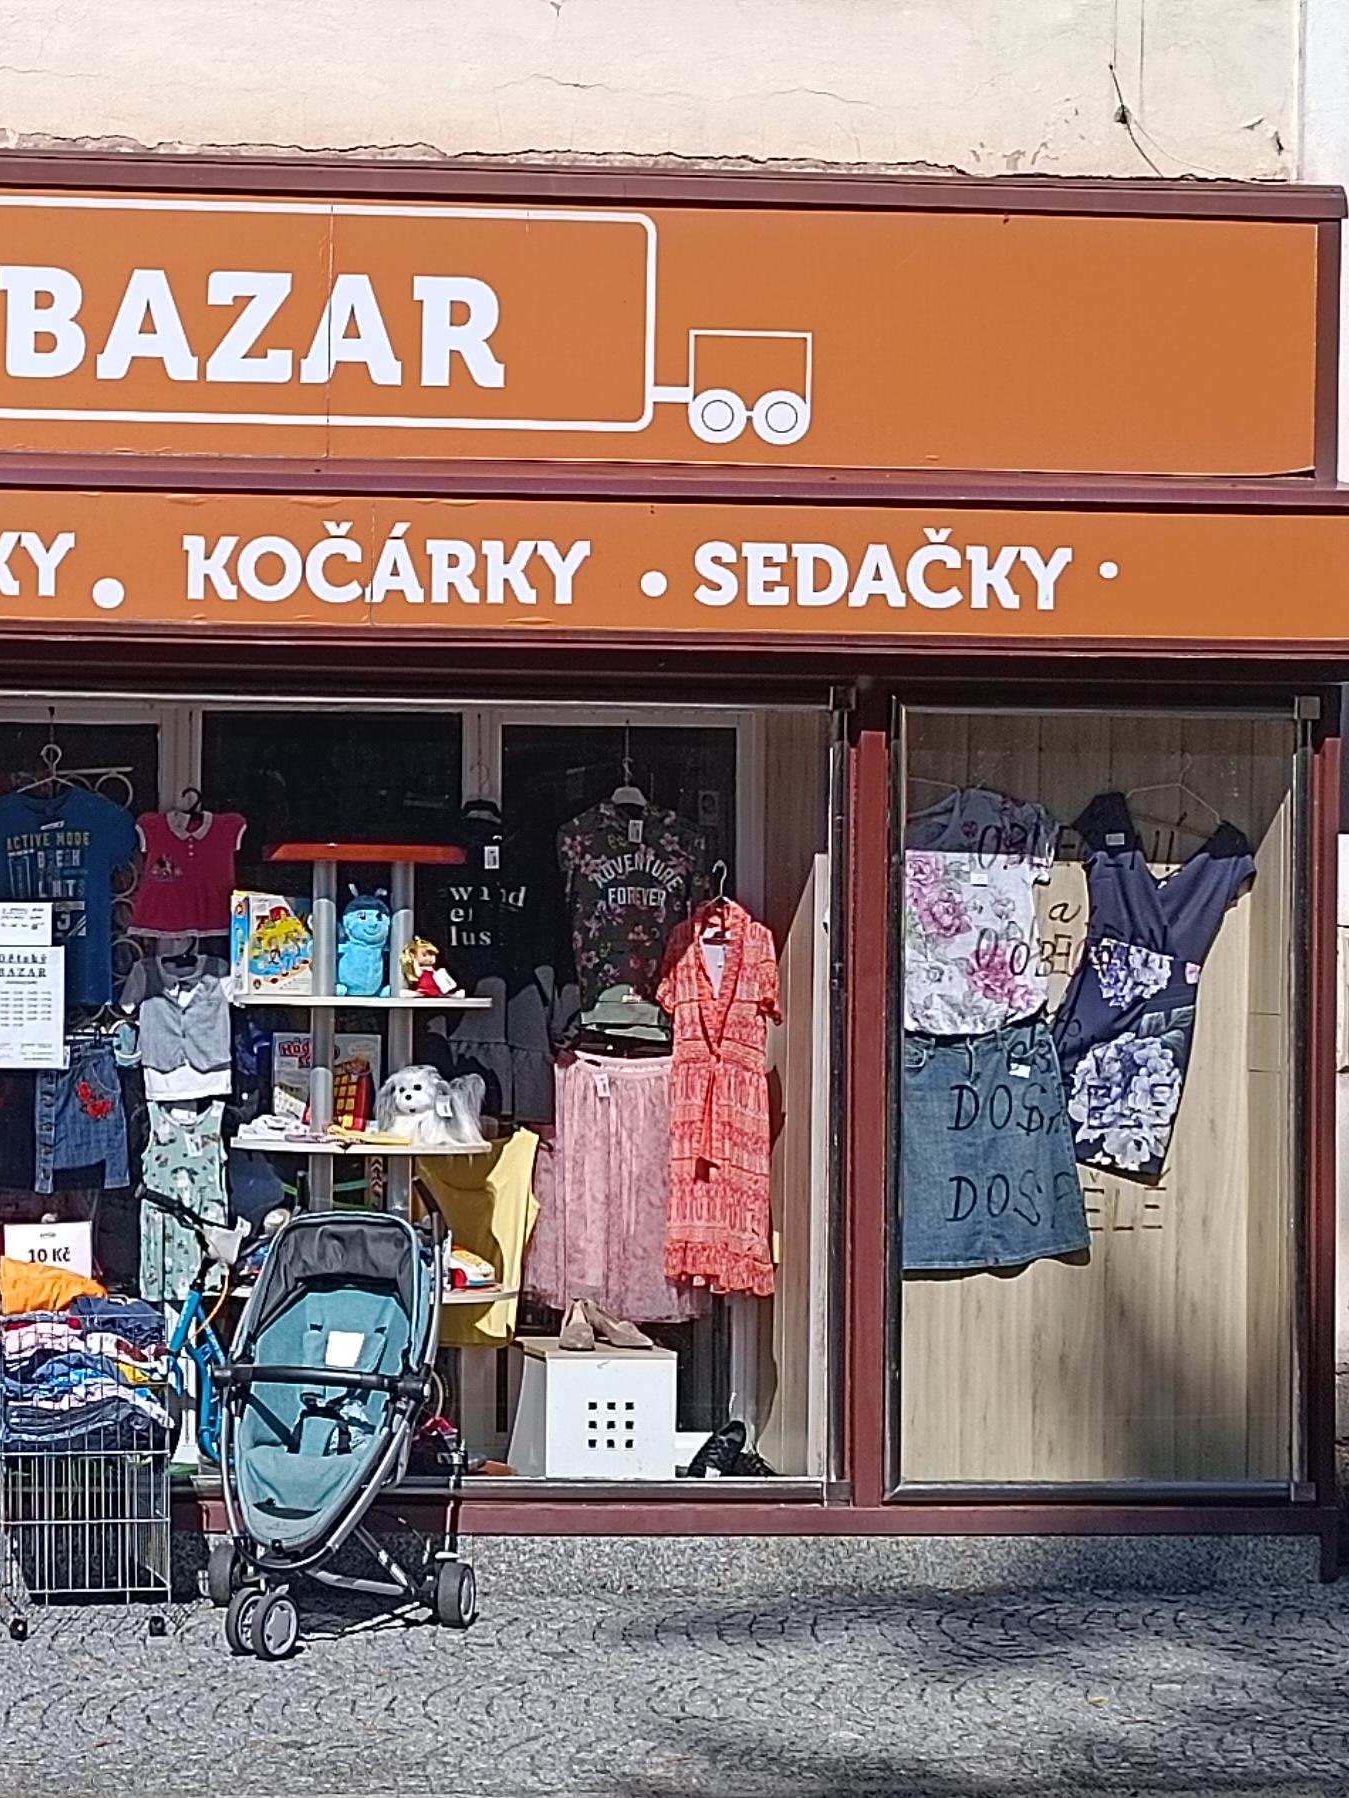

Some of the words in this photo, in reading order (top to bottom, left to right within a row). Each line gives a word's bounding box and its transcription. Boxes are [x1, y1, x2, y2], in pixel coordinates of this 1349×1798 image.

[183, 521, 592, 606] KOČÁRKY
[694, 528, 1072, 610] SEDAČKY
[6, 832, 50, 851] ACTIVE
[592, 853, 684, 893] ADVENTURE
[608, 886, 666, 907] FOREVER
[28, 1248, 48, 1263] 10
[52, 1247, 71, 1262] Kč
